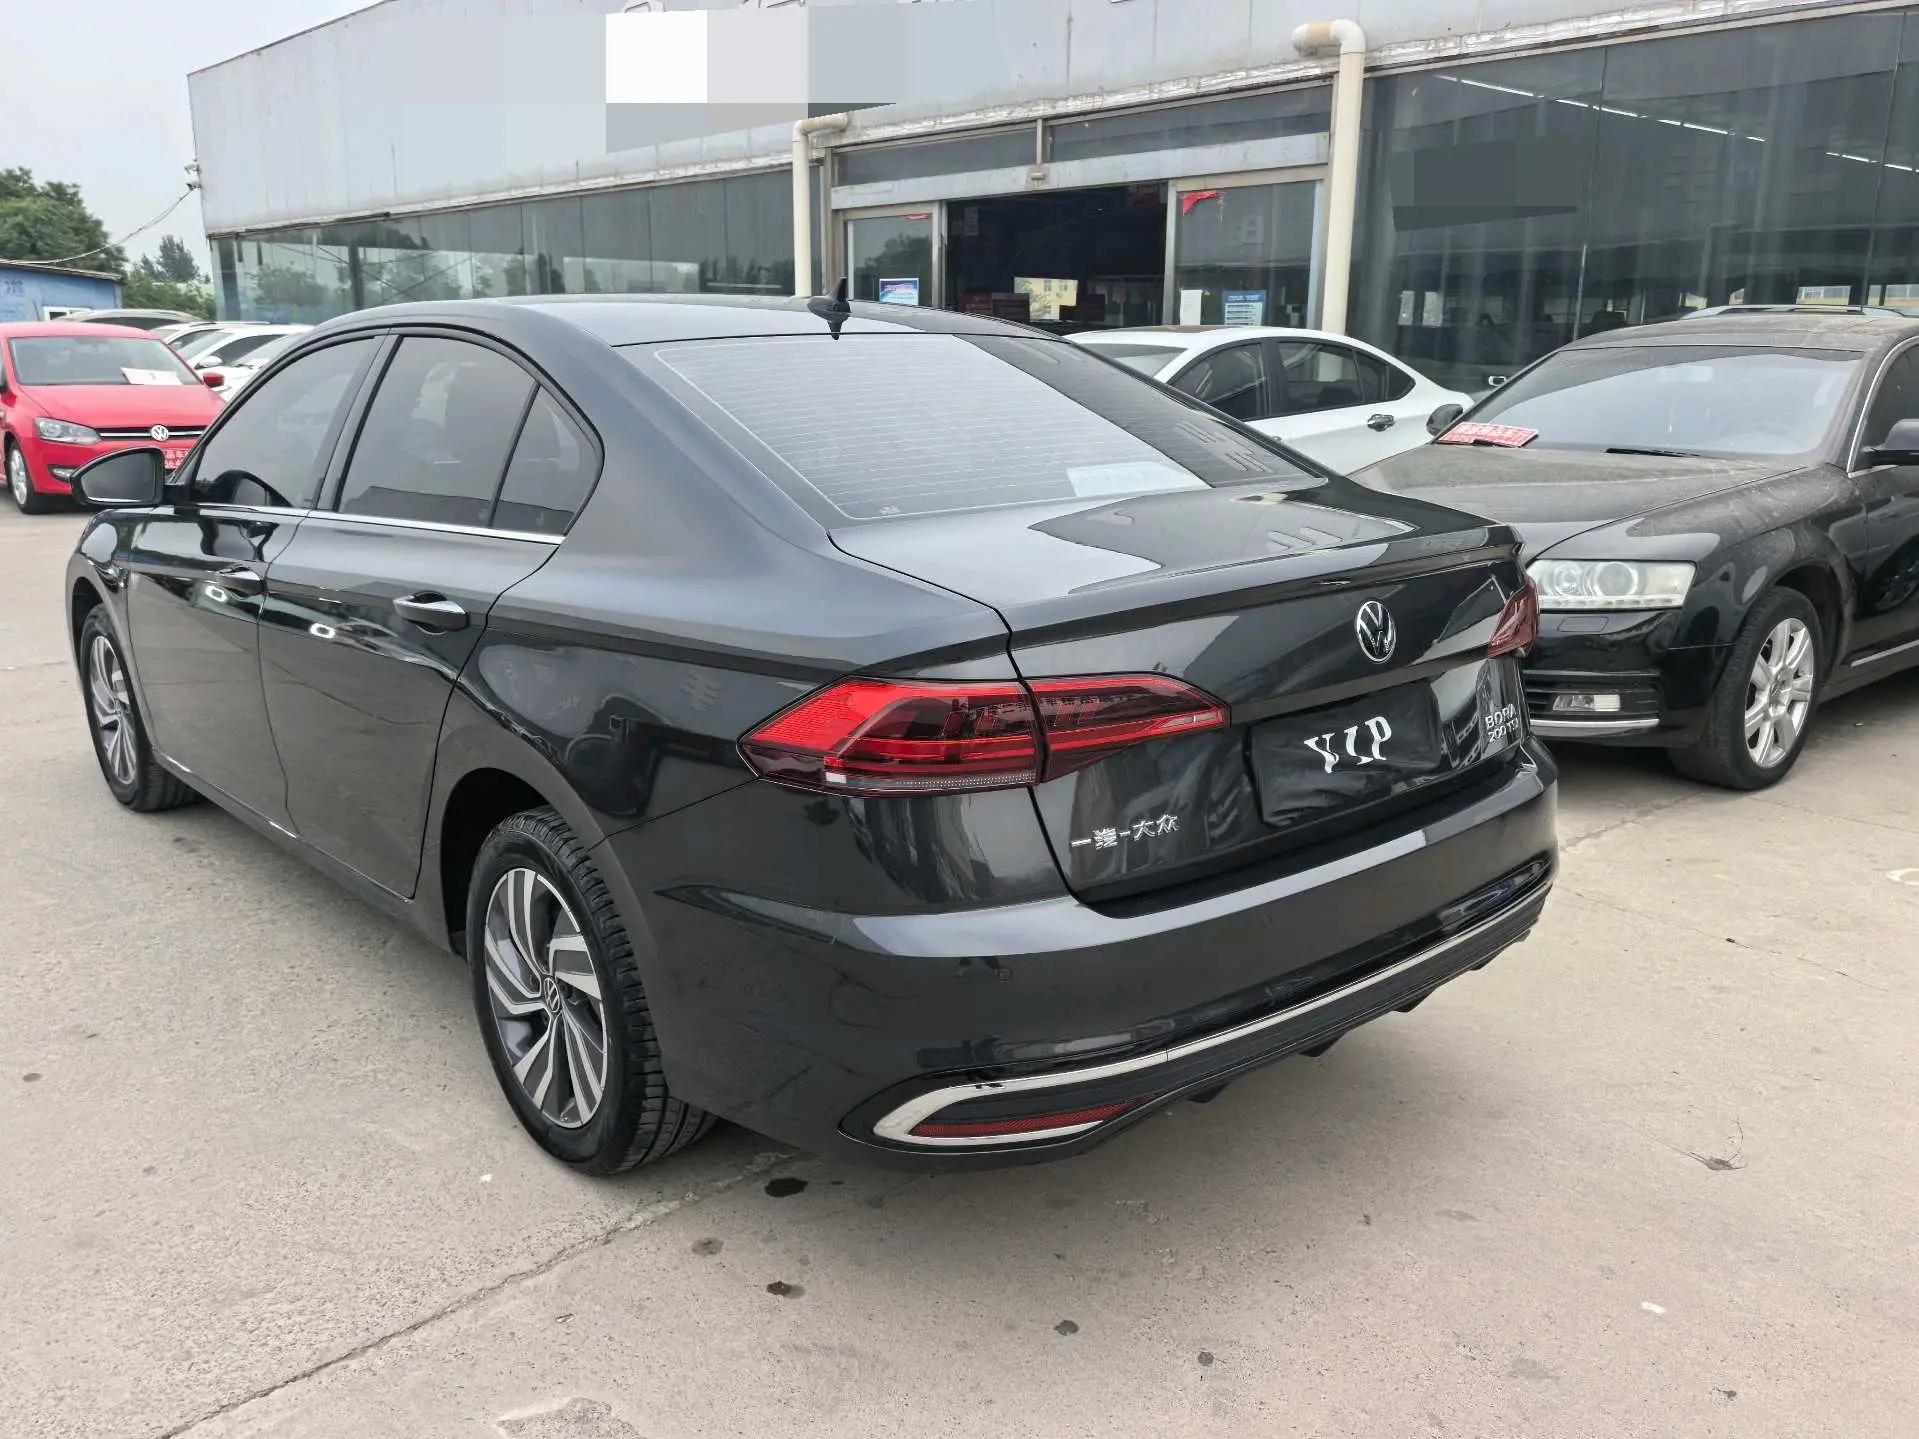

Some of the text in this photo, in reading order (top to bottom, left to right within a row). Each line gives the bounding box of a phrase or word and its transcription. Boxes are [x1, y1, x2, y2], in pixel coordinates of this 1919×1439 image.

[1485, 703, 1516, 730] BORA
[1303, 715, 1393, 774] VIP
[1488, 725, 1506, 743] 200
